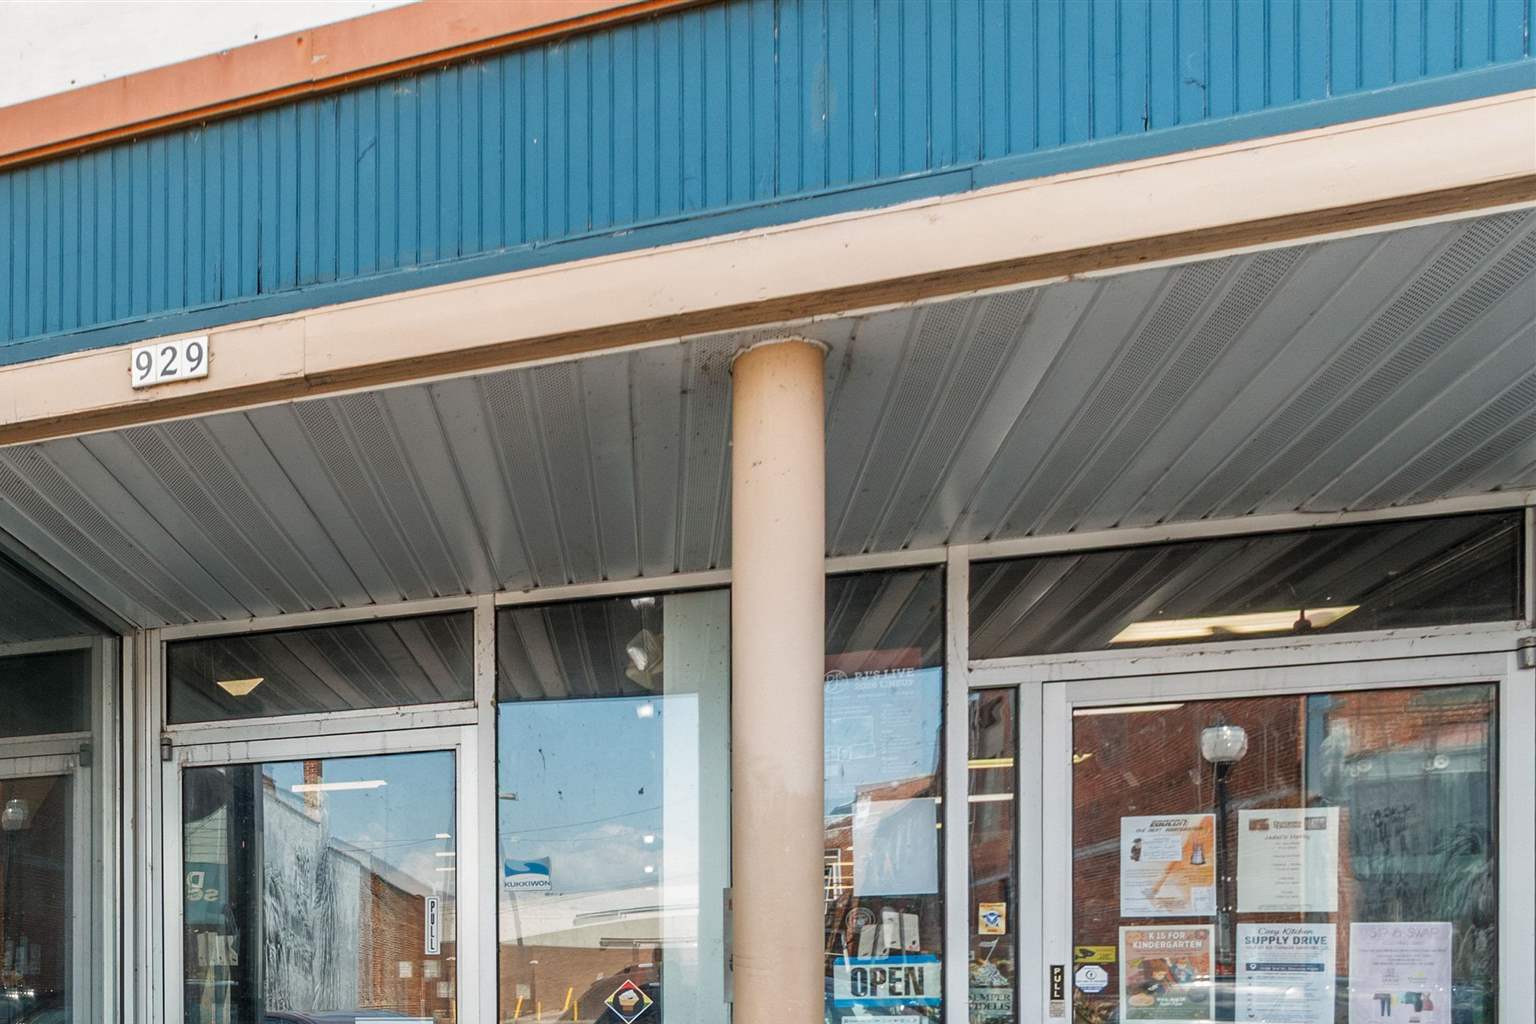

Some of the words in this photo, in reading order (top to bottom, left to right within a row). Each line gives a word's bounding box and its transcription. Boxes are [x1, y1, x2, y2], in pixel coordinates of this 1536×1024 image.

[136, 342, 203, 380] 929
[1132, 940, 1202, 949] KINDERGARTEN
[1245, 936, 1289, 945] SUPPLY
[1292, 936, 1328, 945] DRIVE
[850, 967, 924, 997] OPEN
